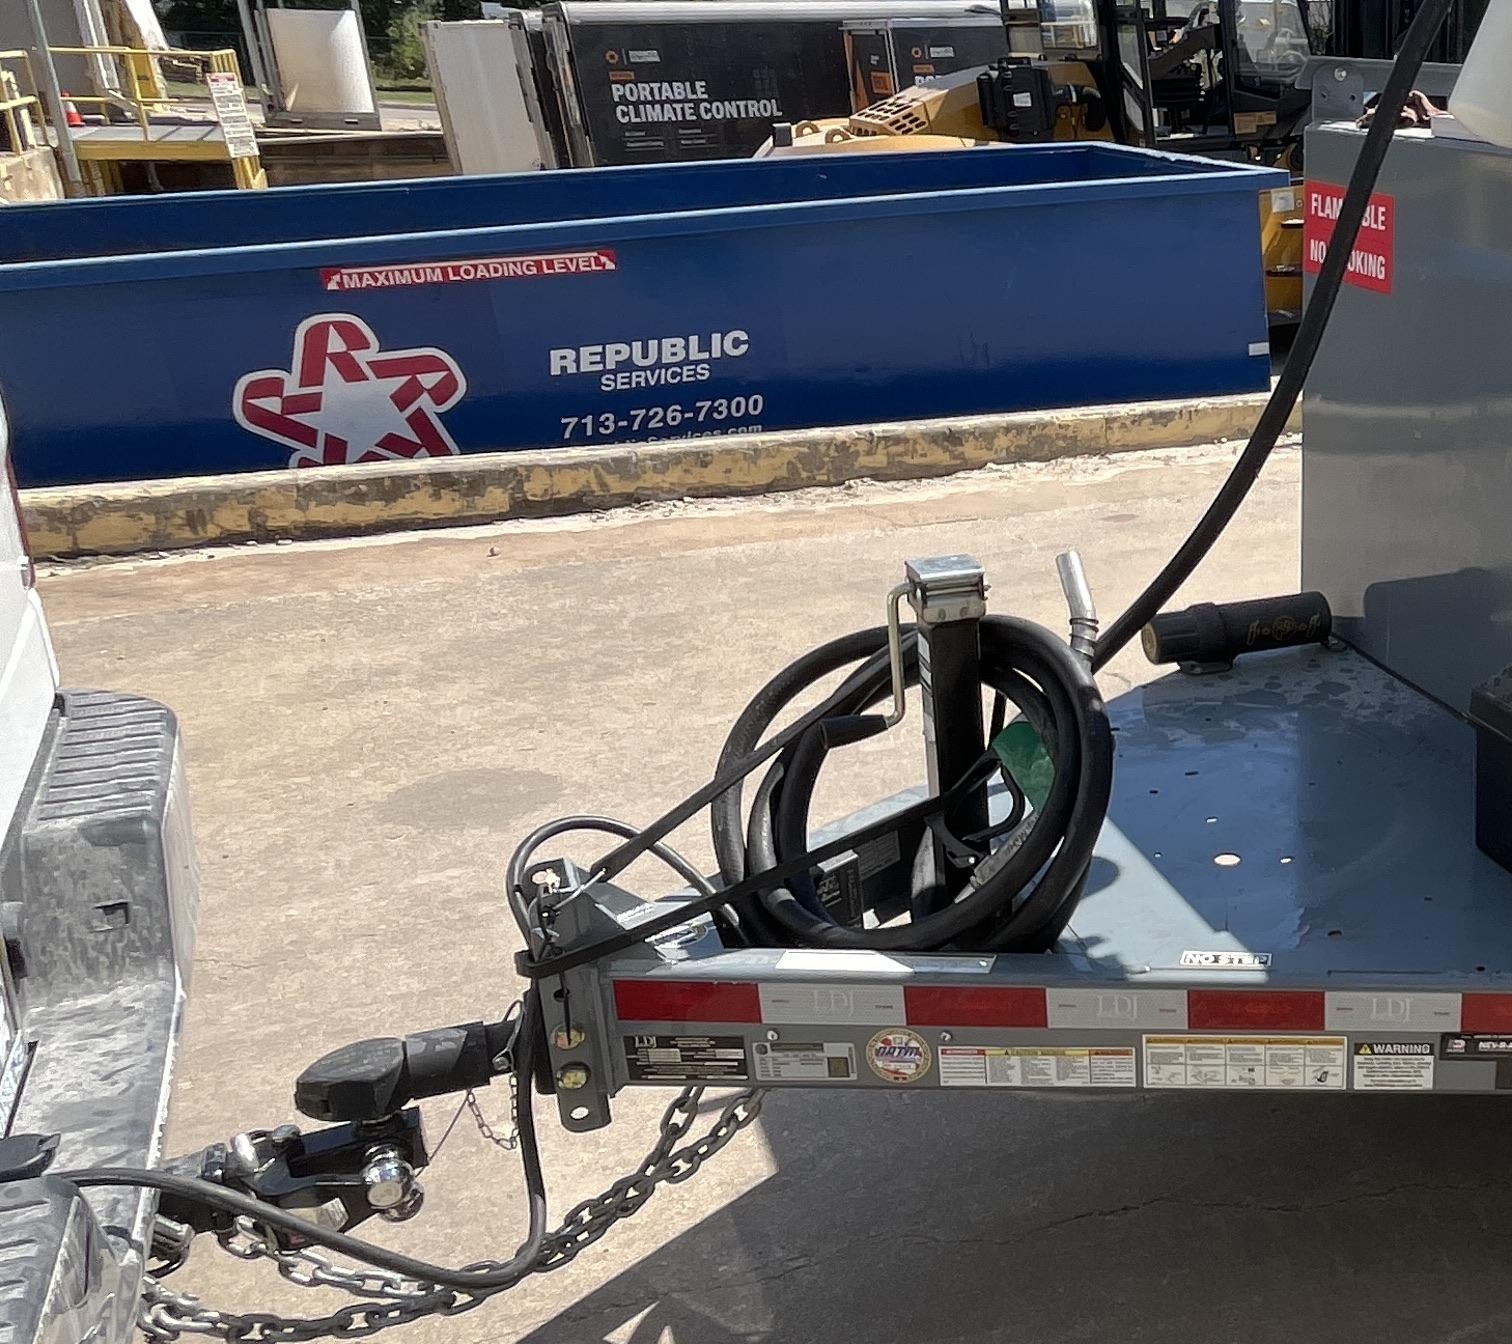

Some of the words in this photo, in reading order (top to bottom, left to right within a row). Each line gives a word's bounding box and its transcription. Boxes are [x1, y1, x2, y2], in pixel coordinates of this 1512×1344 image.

[611, 81, 709, 102] PORTABLE
[616, 102, 698, 124] CLIMATE
[699, 99, 783, 120] CONTROL
[1311, 193, 1386, 231] FLAMBLE
[343, 269, 443, 289] MAXIMUM
[448, 260, 538, 281] LOADING
[542, 256, 604, 274] LEVEL
[1347, 250, 1386, 280] OKING
[550, 329, 749, 376] REPUBLIC
[601, 363, 711, 392] SERVICES
[560, 394, 764, 440] 713-726-7300
[1373, 1043, 1431, 1054] WARNING
